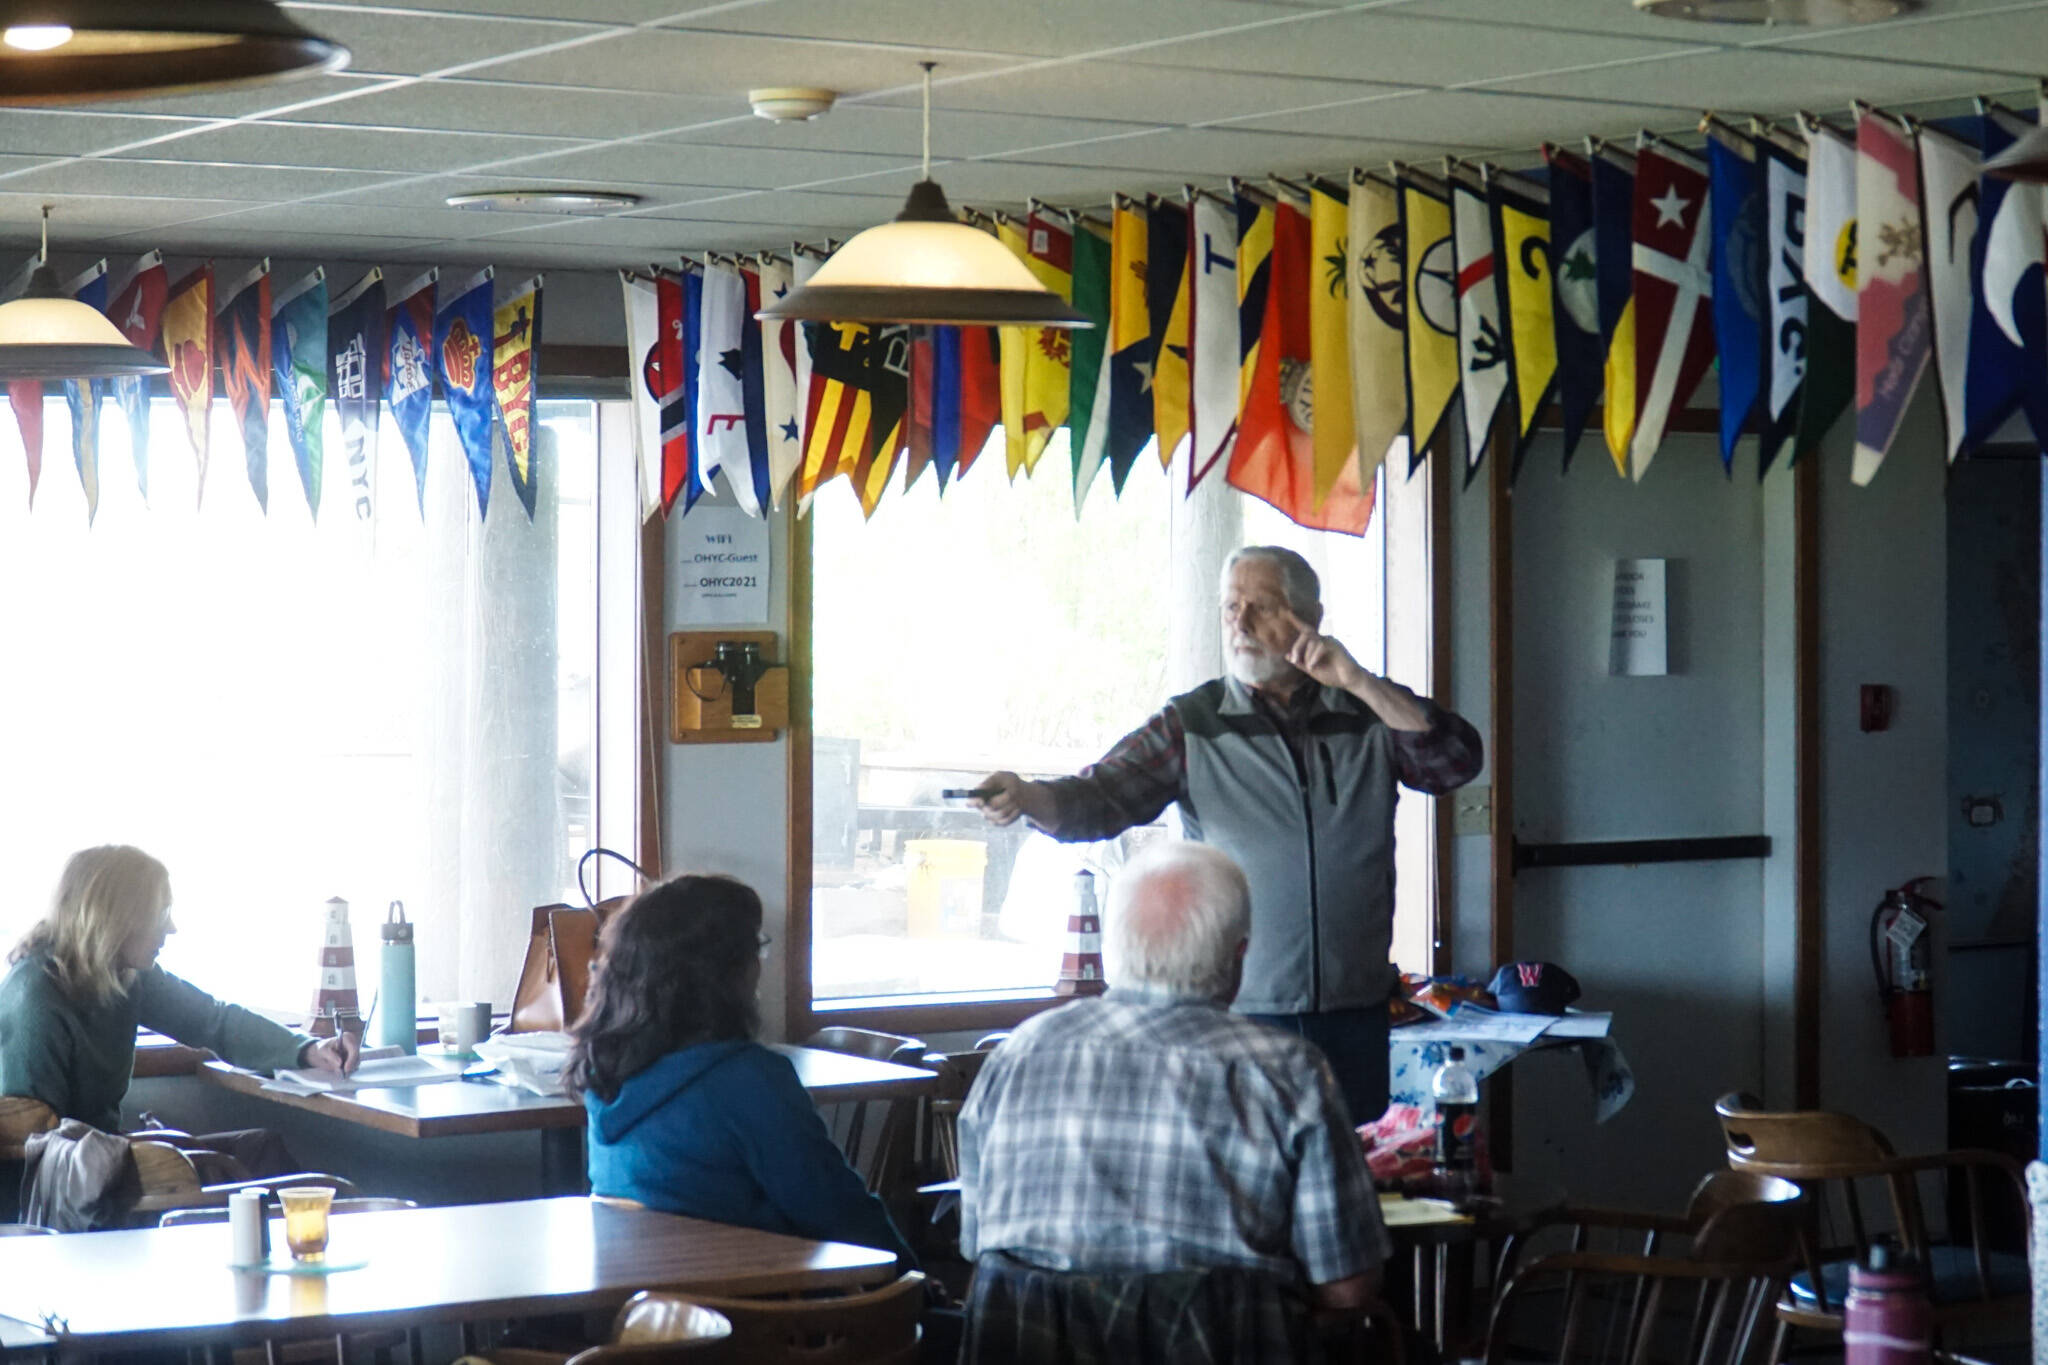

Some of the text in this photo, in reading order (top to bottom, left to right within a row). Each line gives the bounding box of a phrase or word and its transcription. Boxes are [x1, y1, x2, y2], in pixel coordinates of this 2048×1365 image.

[345, 434, 373, 521] NYC
[694, 552, 758, 564] OHYC-Guest
[699, 576, 757, 588] OHYC2021
[1517, 963, 1542, 987] W
